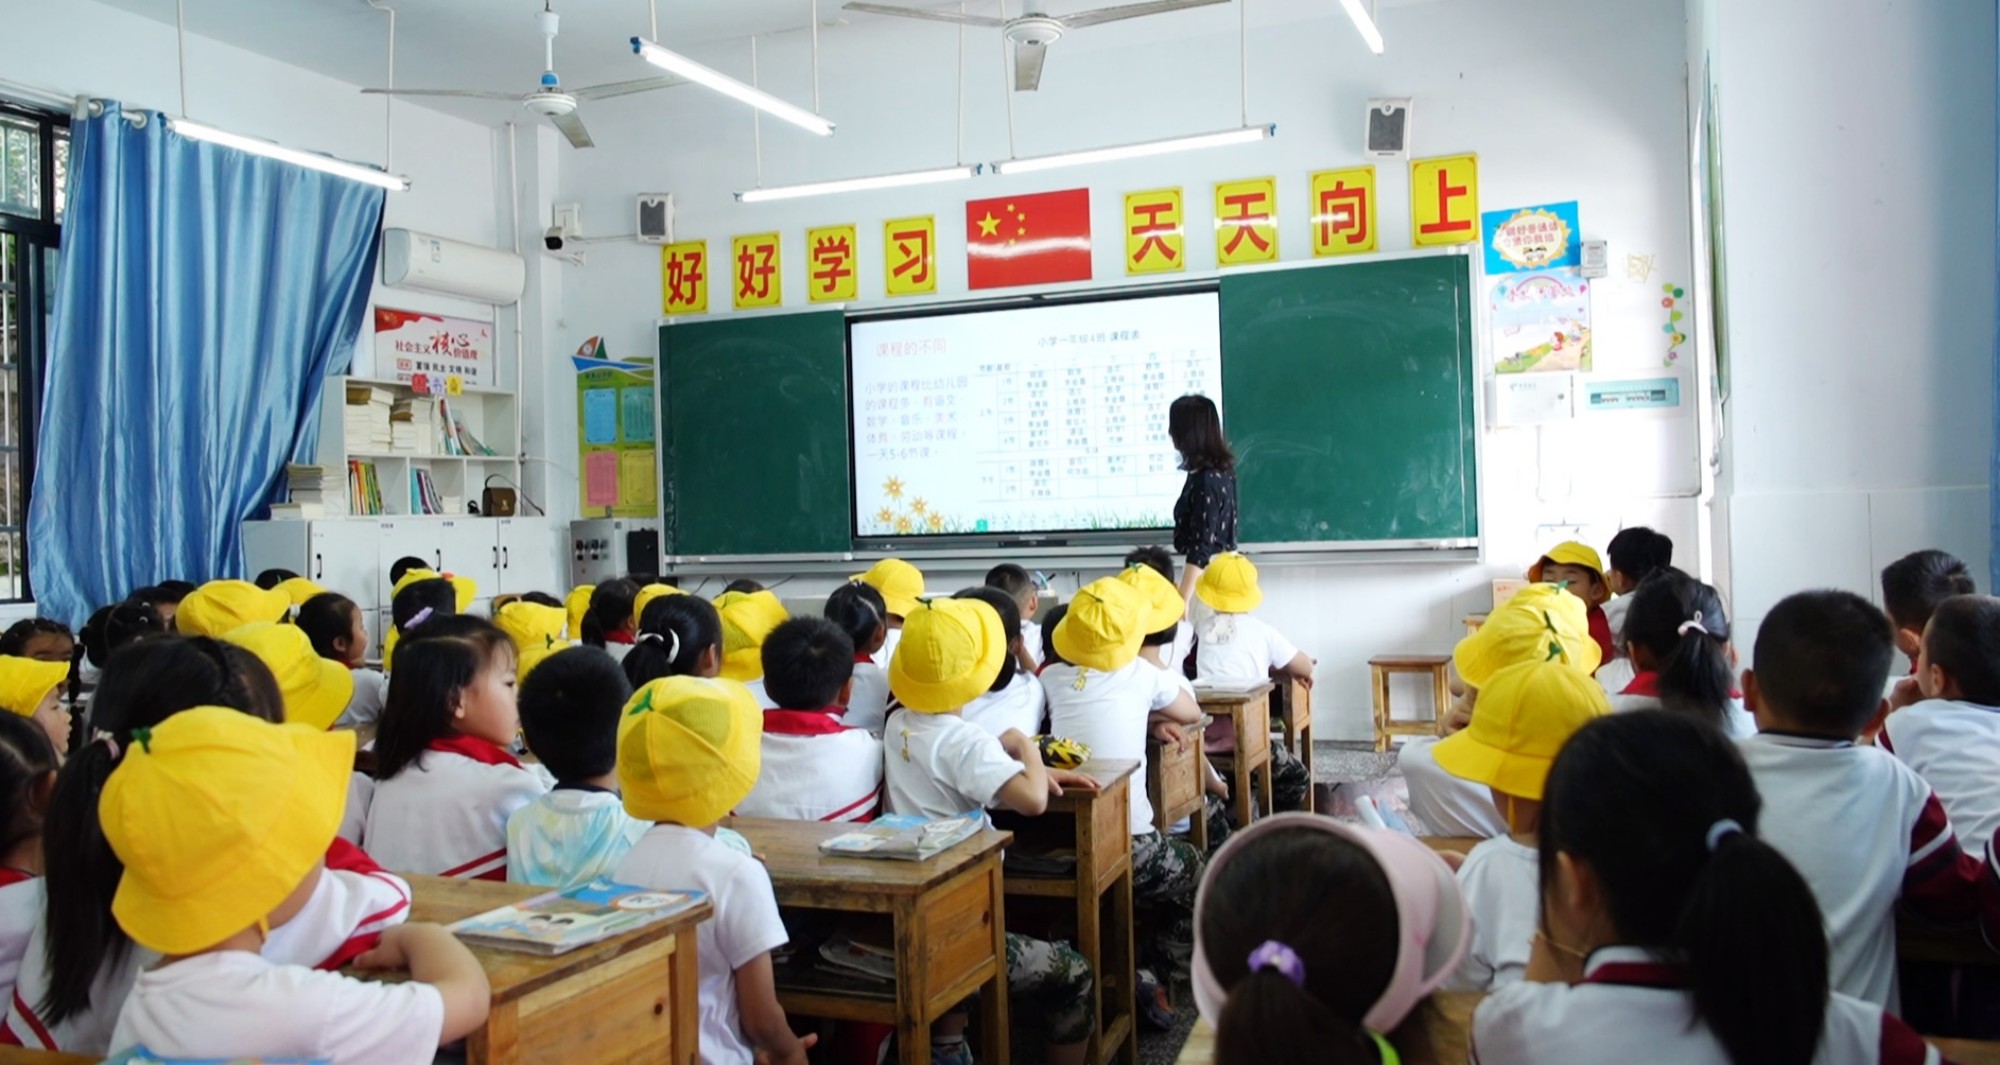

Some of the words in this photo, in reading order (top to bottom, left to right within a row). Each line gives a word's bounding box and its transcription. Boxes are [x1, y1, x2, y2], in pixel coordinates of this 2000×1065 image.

[1131, 168, 1472, 264] 天天向上
[666, 228, 931, 305] 好好学习
[876, 337, 947, 357] 课程的不同
